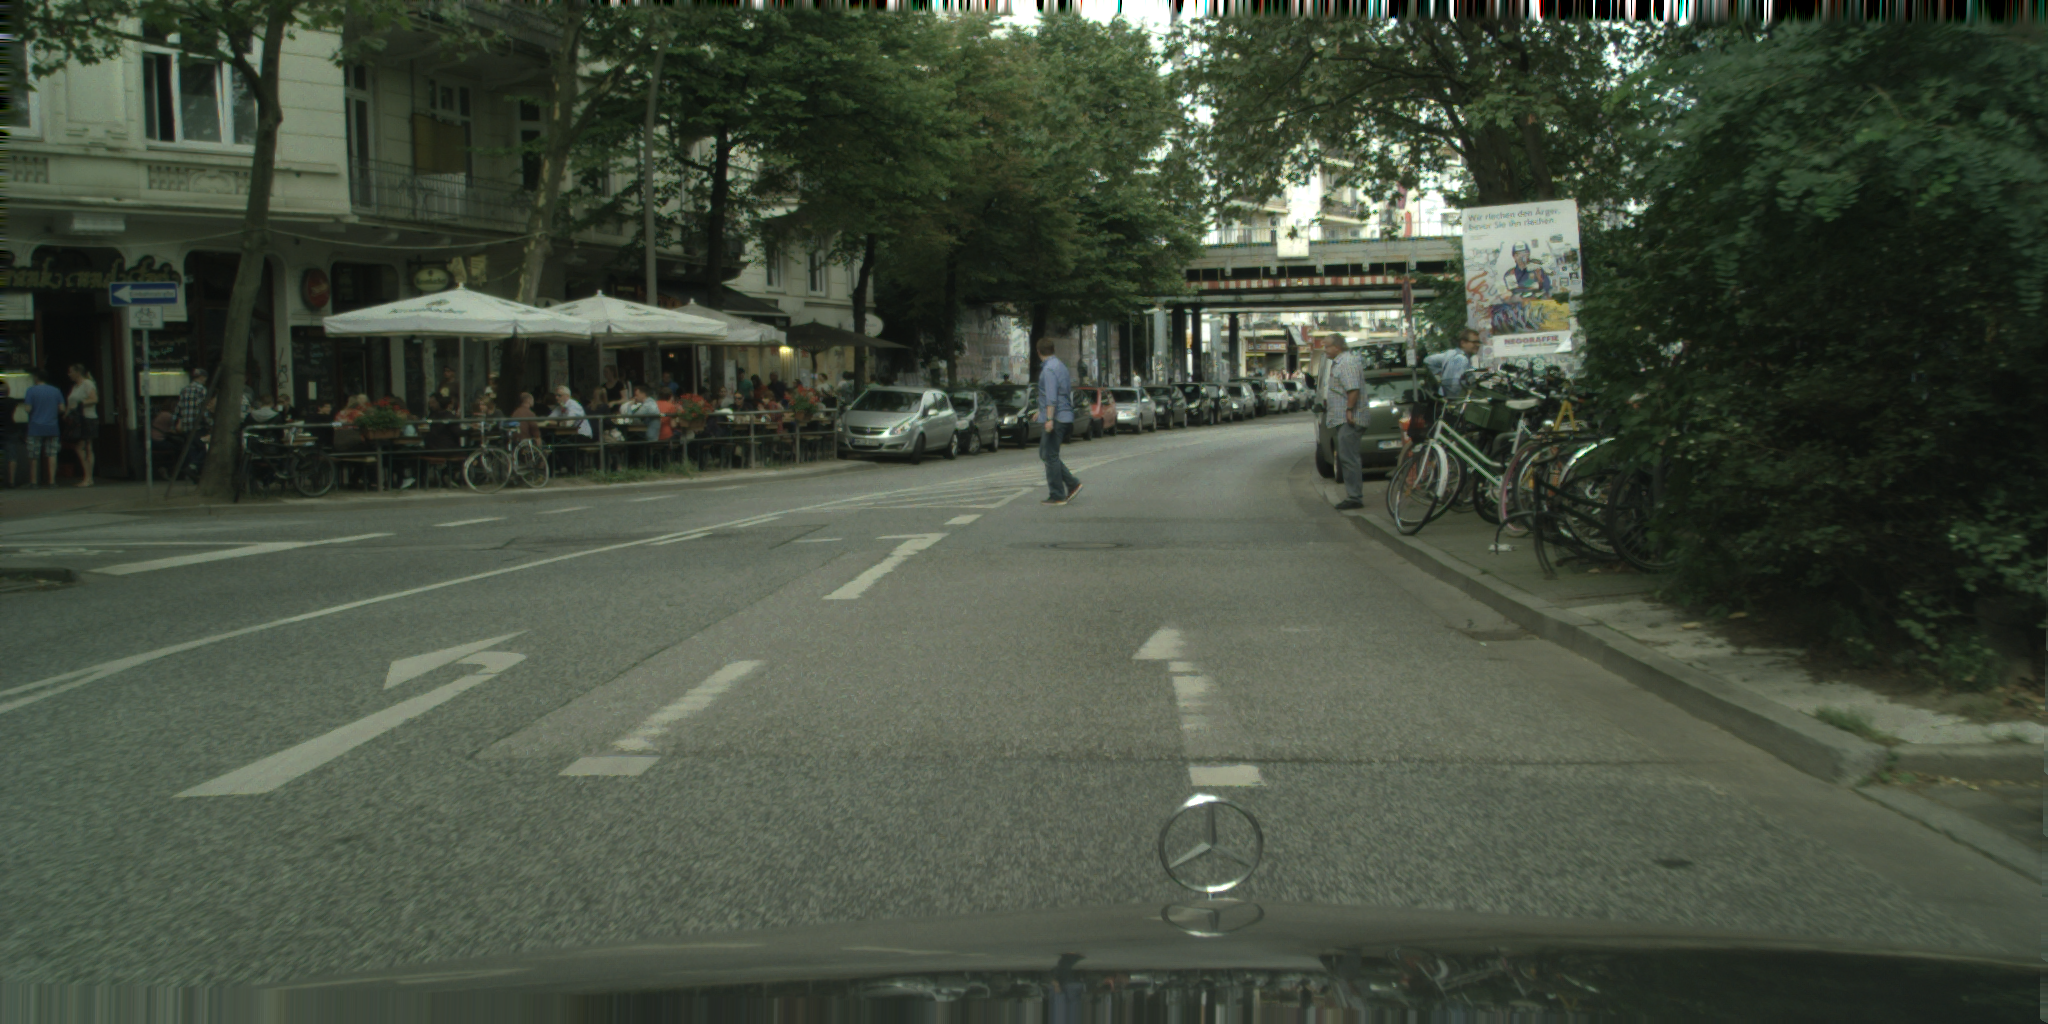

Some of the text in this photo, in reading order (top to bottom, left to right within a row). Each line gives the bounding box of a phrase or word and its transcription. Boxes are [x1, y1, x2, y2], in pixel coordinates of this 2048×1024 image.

[1467, 213, 1483, 222] Wir
[1485, 211, 1516, 220] riechen
[1517, 209, 1533, 218] den
[1494, 220, 1507, 229] Sie
[1508, 219, 1522, 228] ihn
